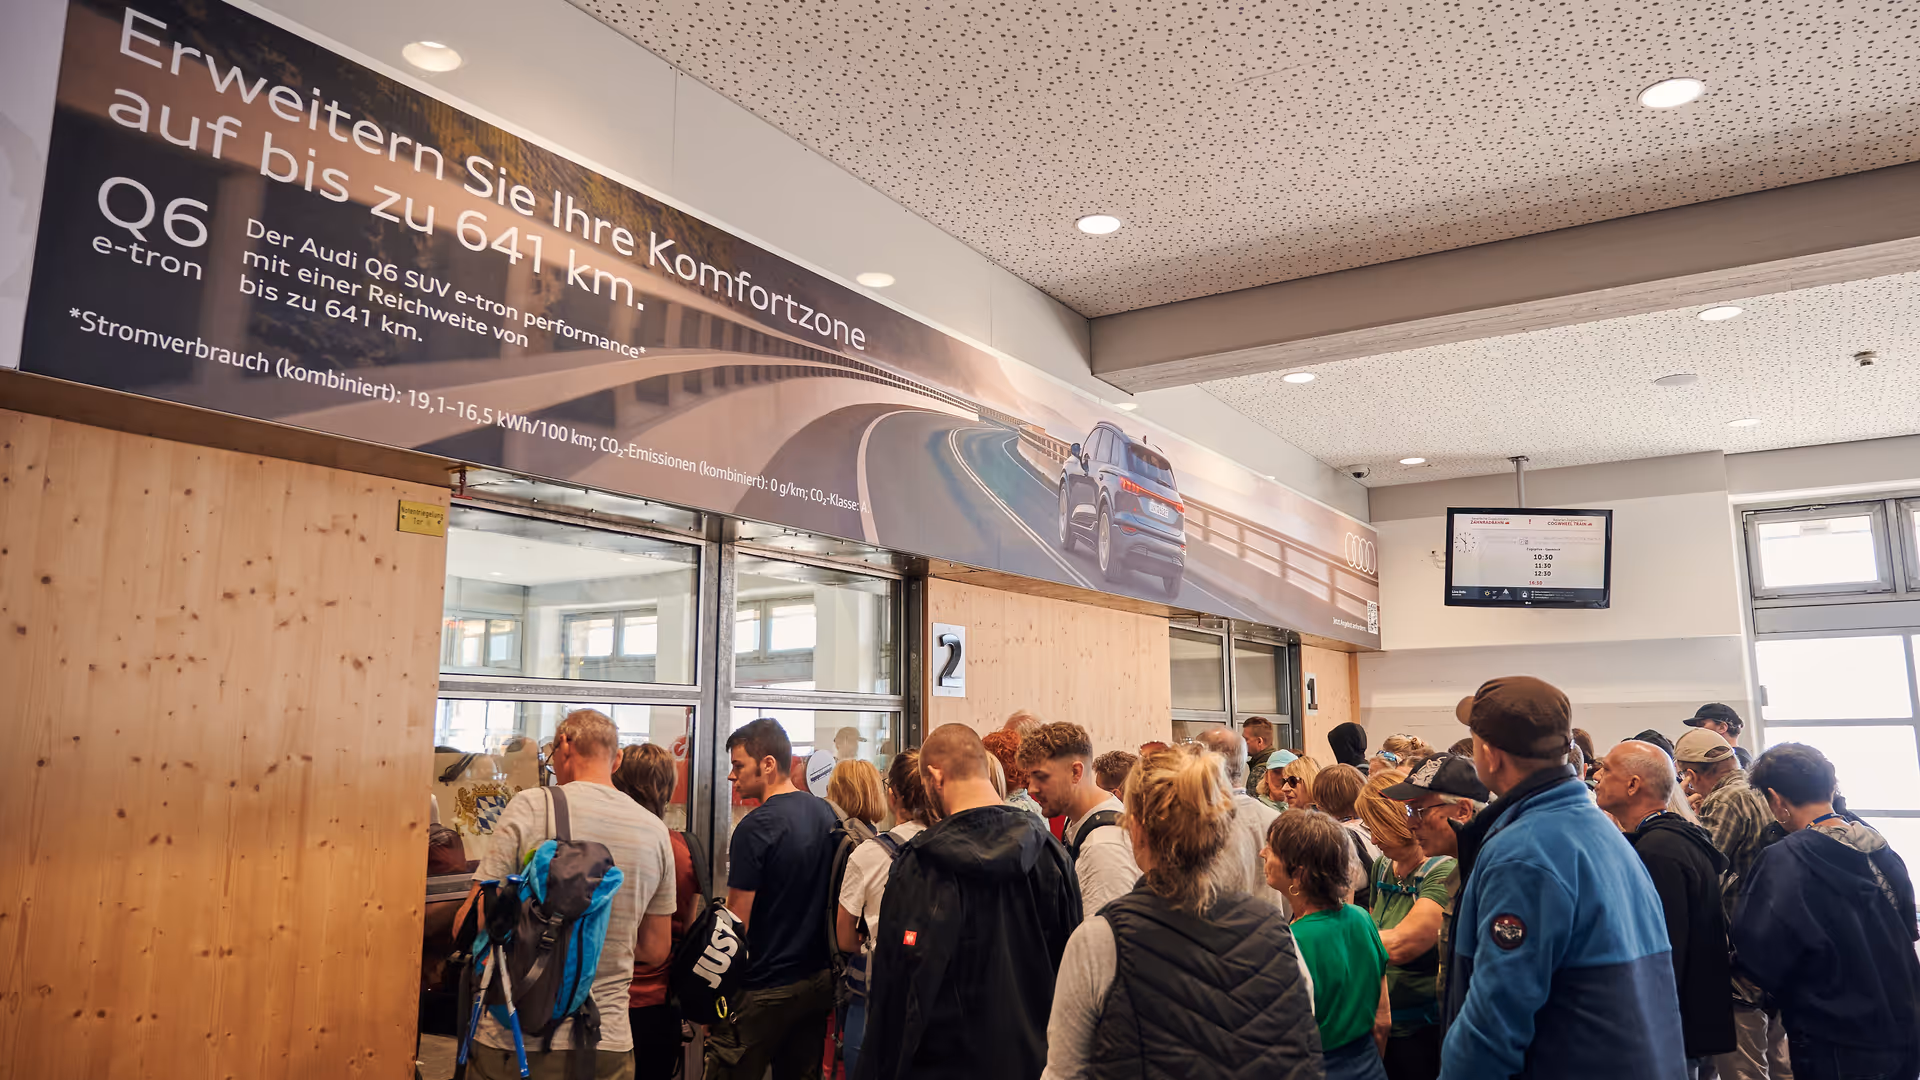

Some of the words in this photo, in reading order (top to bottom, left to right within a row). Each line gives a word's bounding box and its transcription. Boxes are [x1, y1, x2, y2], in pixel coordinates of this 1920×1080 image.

[98, 176, 209, 248] Q6
[108, 87, 242, 159] auf
[260, 131, 350, 203] bis
[370, 184, 435, 235] zu
[456, 210, 542, 274] 641
[567, 248, 644, 311] km.
[119, 6, 444, 181] Erweitern
[463, 155, 536, 216] Sie
[552, 190, 634, 256] Ihre
[649, 231, 866, 350] Komfortzone
[92, 235, 202, 281] e-tron
[242, 250, 291, 277] mit
[297, 267, 362, 297] einer
[368, 283, 488, 335] Reichweite
[492, 325, 529, 348] von
[246, 218, 294, 248] Der
[299, 238, 358, 270] Audi
[364, 257, 399, 282] Q6
[404, 270, 451, 298] SUV
[455, 290, 519, 321] e-tron
[239, 273, 279, 301] bis
[286, 292, 317, 313] zu
[325, 299, 371, 328] 641
[381, 314, 423, 342] km.
[275, 357, 402, 404] (kombiniert):
[496, 410, 569, 442] kWh/100
[571, 428, 598, 452] km;
[699, 460, 769, 491] (kombiniert):
[770, 478, 778, 492] 0
[779, 482, 809, 501] g/km;
[937, 633, 963, 688] 2
[1306, 677, 1319, 711] 1
